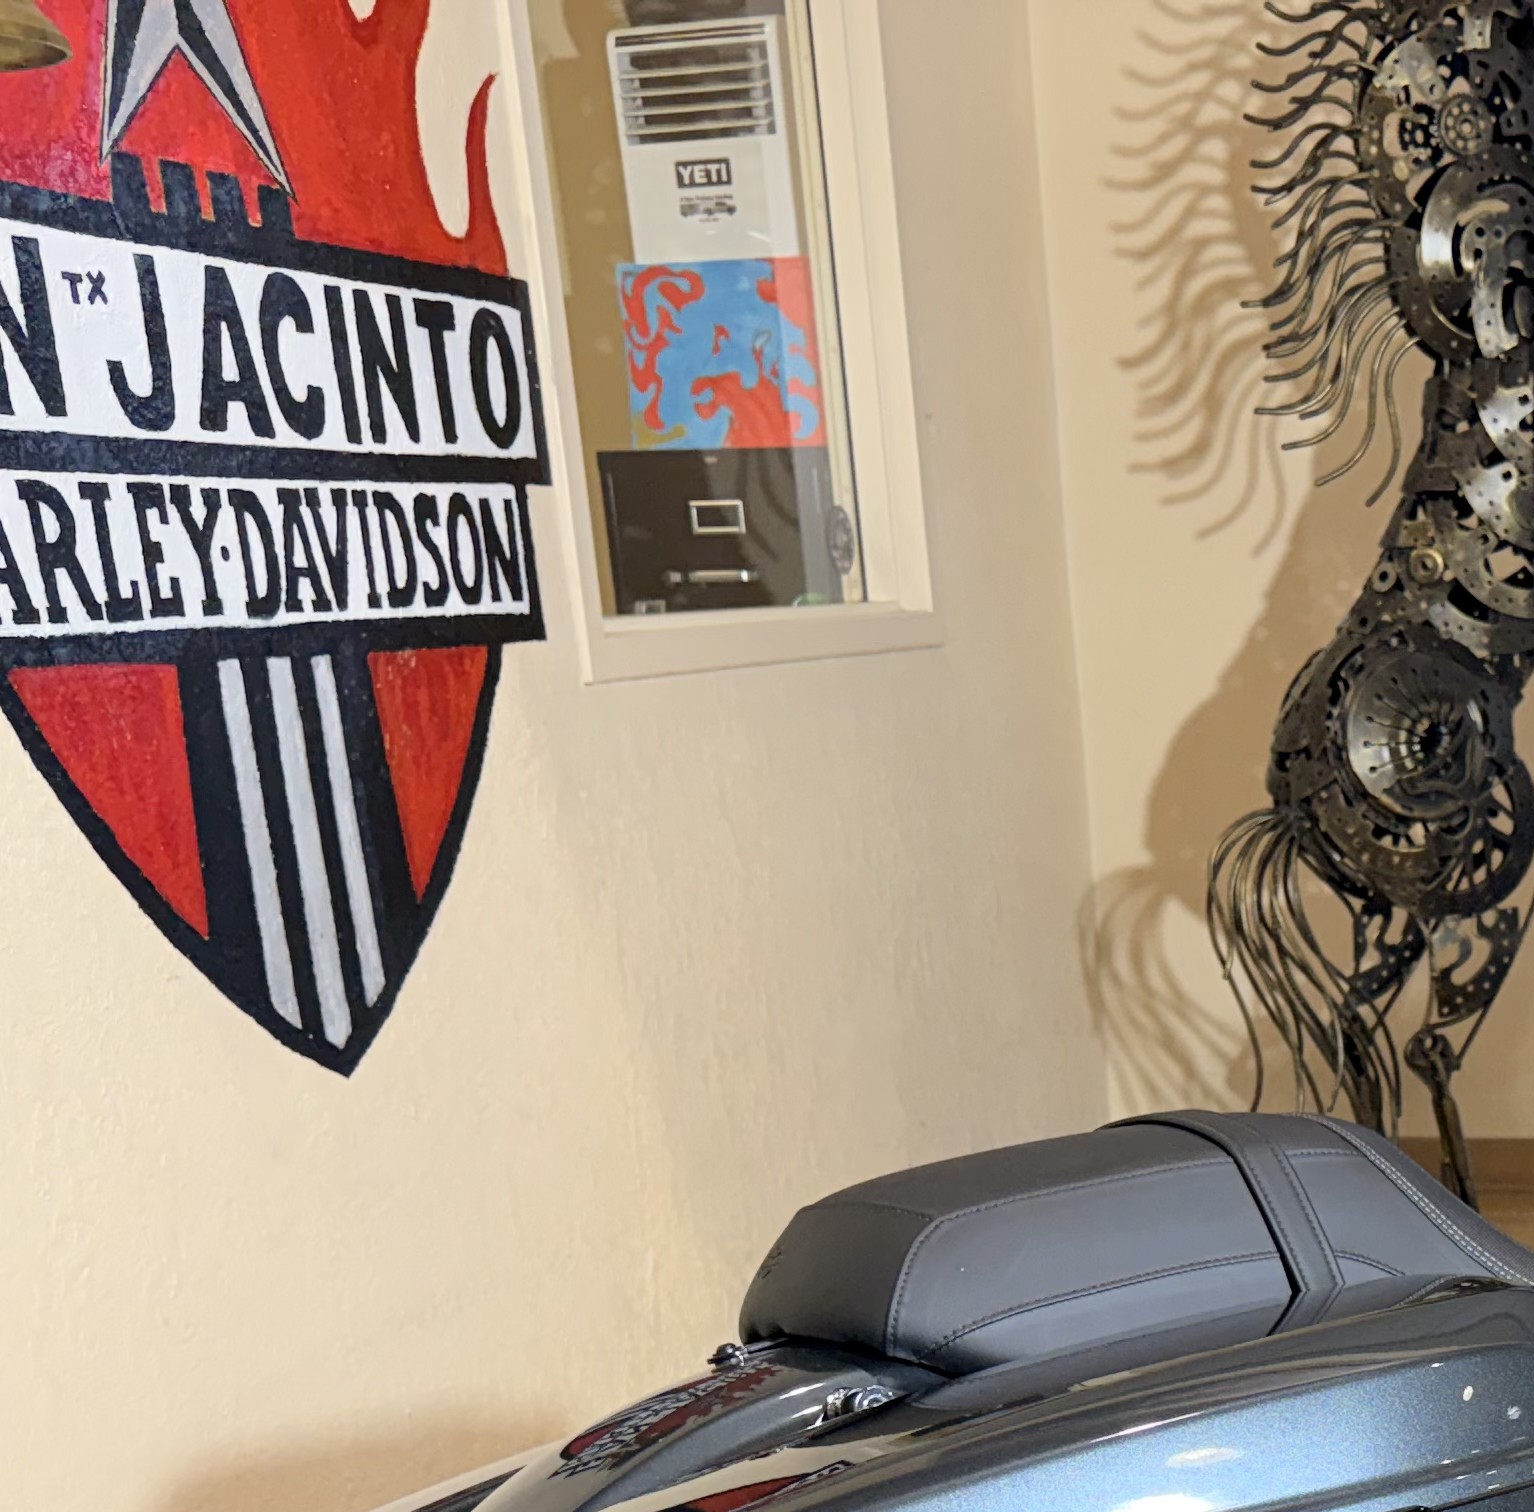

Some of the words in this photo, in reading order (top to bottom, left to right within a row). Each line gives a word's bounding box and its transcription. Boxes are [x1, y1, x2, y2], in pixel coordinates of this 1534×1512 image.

[678, 162, 728, 185] YETI
[61, 270, 108, 305] TX
[106, 252, 521, 449] JACINTO
